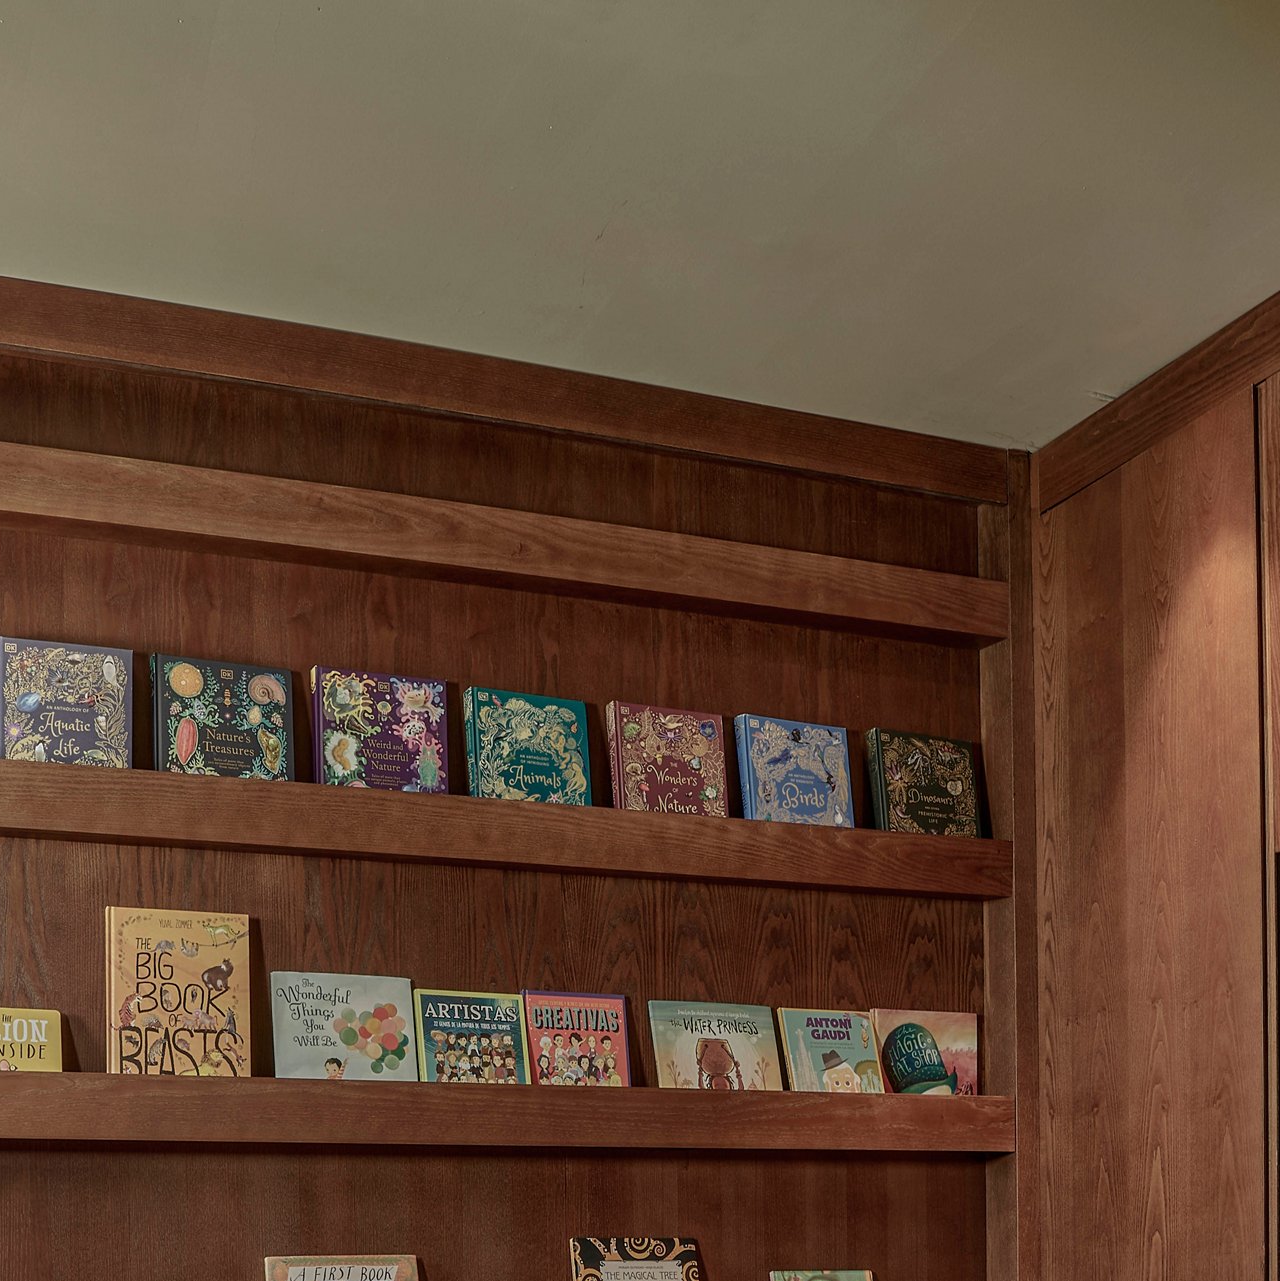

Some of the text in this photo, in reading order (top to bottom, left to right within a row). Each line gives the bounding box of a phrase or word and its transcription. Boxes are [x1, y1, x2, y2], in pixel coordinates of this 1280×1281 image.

[38, 712, 91, 738] Aquatic
[206, 728, 250, 744] Nature's
[367, 738, 392, 750] Weird
[54, 738, 80, 756] Life
[202, 740, 254, 756] Treasures
[362, 748, 409, 762] Wonderful
[371, 760, 401, 772] Nature
[508, 765, 562, 791] Animals
[646, 764, 698, 786] Wonders
[654, 793, 698, 814] Nature
[782, 782, 825, 808] Birds
[908, 788, 954, 805] Dinosaurs
[918, 810, 948, 818] PREHISTORIC
[158, 918, 193, 928] YUVAL ZOMMER
[136, 938, 152, 950] THE
[136, 952, 174, 980] BIG
[302, 978, 314, 988] The
[136, 981, 228, 1017] BOOK
[276, 984, 352, 1006] Wonderful
[2, 1014, 12, 1022] THE
[169, 1013, 183, 1027] OF
[289, 1002, 335, 1021] Things
[424, 1002, 517, 1022] ARTISTAS
[532, 1006, 620, 1032] CREATIVAS
[303, 1019, 325, 1033] You
[683, 1017, 716, 1036] WATER
[717, 1019, 759, 1035] PRINCESS
[806, 1017, 852, 1029] ANTONI
[293, 1036, 338, 1047] Will Be
[889, 1032, 927, 1066] MAGIC
[119, 1026, 244, 1077] BEASTS
[892, 1049, 938, 1081] HAT SHOP
[314, 1266, 355, 1281] FIRST
[360, 1266, 394, 1281] BOOK
[605, 1272, 678, 1280] THE MAGICAL TREE
